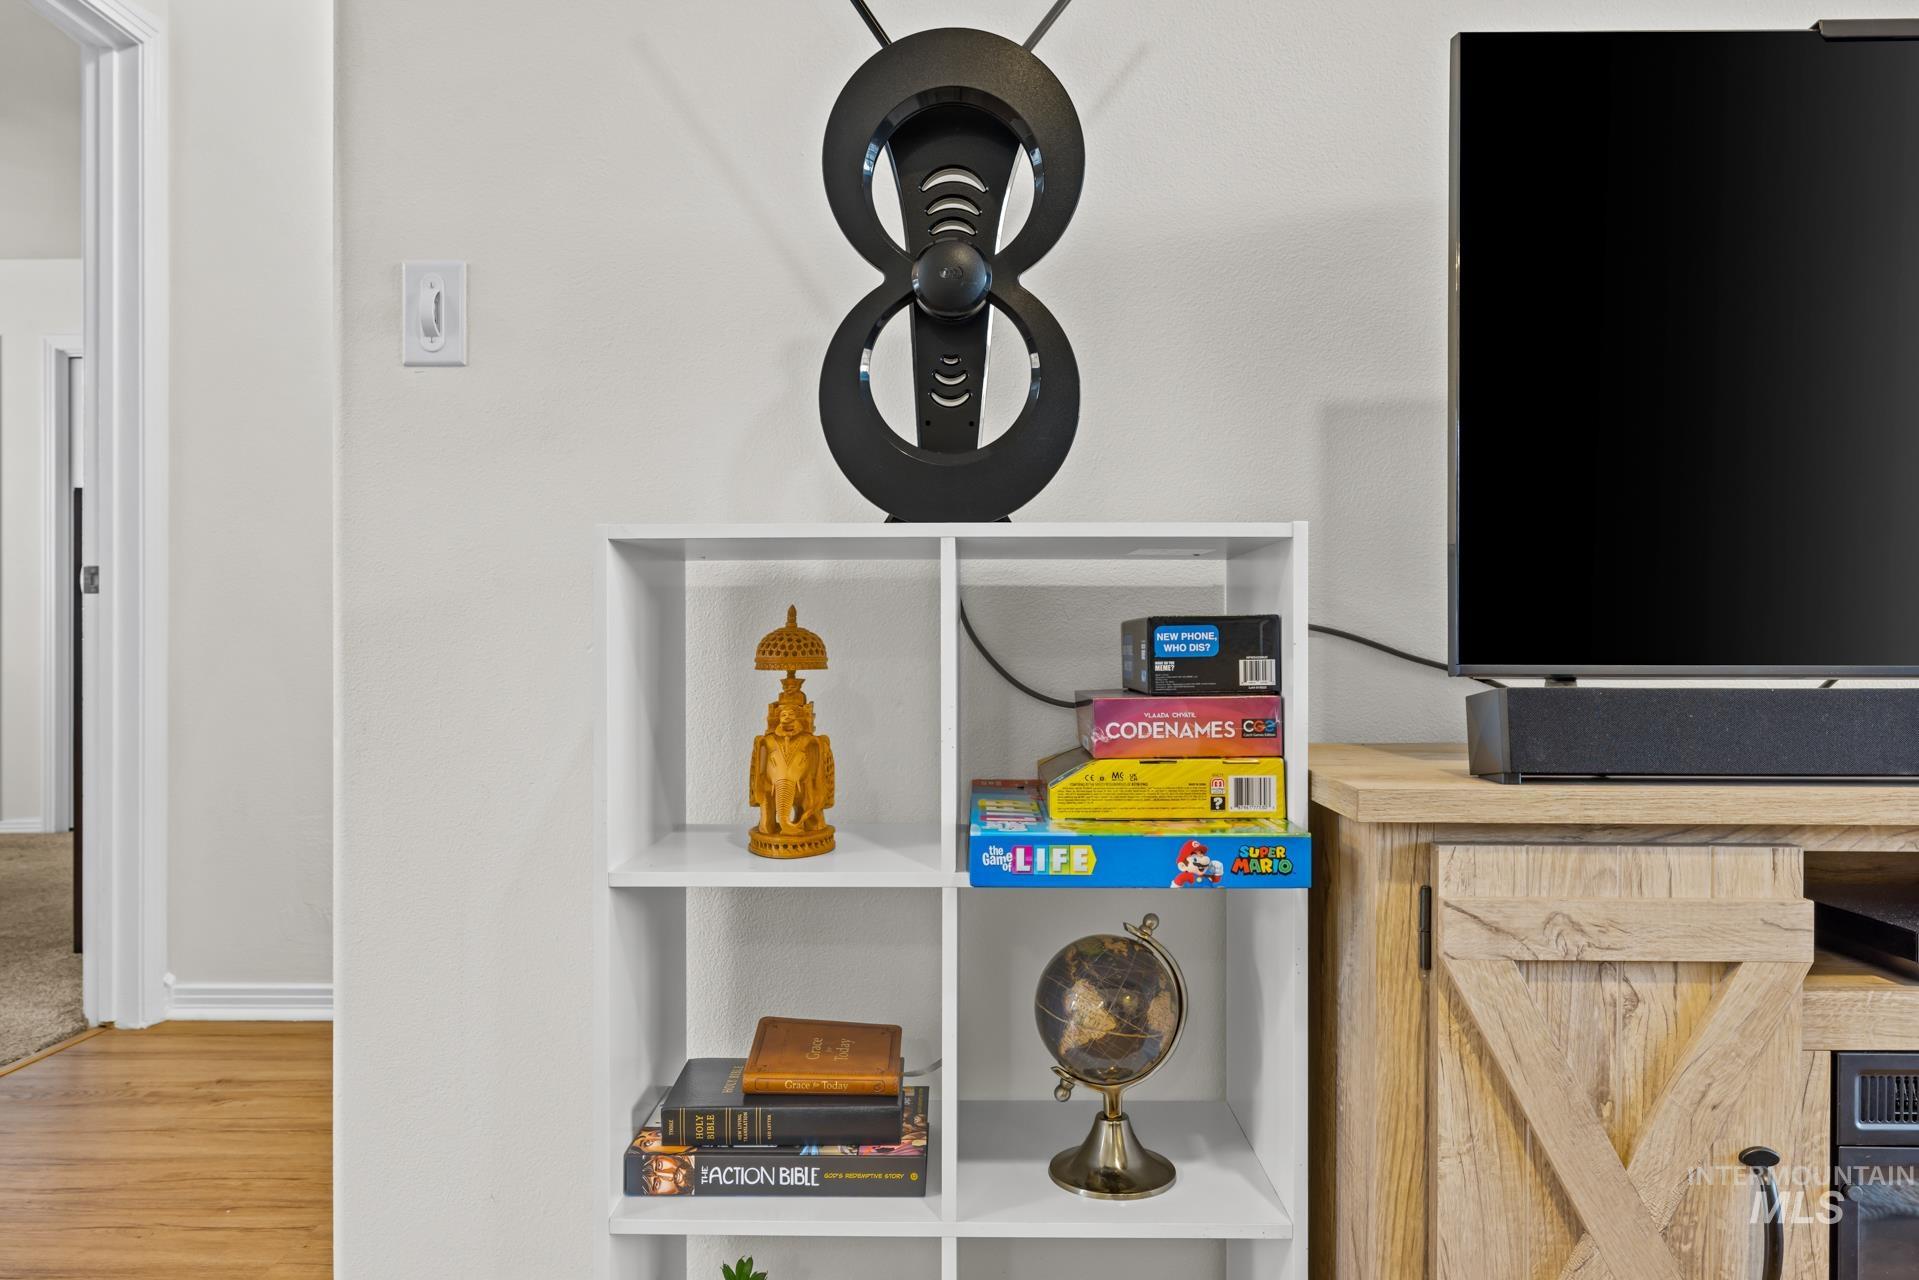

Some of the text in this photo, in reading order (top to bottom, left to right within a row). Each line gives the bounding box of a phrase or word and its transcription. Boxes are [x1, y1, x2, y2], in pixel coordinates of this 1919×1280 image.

[1156, 631, 1218, 642] NEW PHONE,
[1163, 643, 1211, 652] WHO DIS?
[1105, 720, 1236, 740] CODENAMES
[982, 847, 1089, 872] Game LIFE
[988, 845, 1004, 856] the
[1239, 845, 1286, 858] SUPER
[1002, 861, 1013, 873] of
[1231, 857, 1294, 875] MARIO
[805, 1037, 824, 1060] Grace
[834, 1038, 855, 1062] Today
[784, 1080, 810, 1090] Grace
[822, 1080, 849, 1091] Today
[695, 1114, 704, 1140] HOLY
[706, 1113, 715, 1140] BIBLE
[701, 1165, 709, 1185] THE
[709, 1166, 776, 1186] ACTION
[779, 1166, 820, 1186] BIBLE
[884, 1172, 905, 1180] STORY
